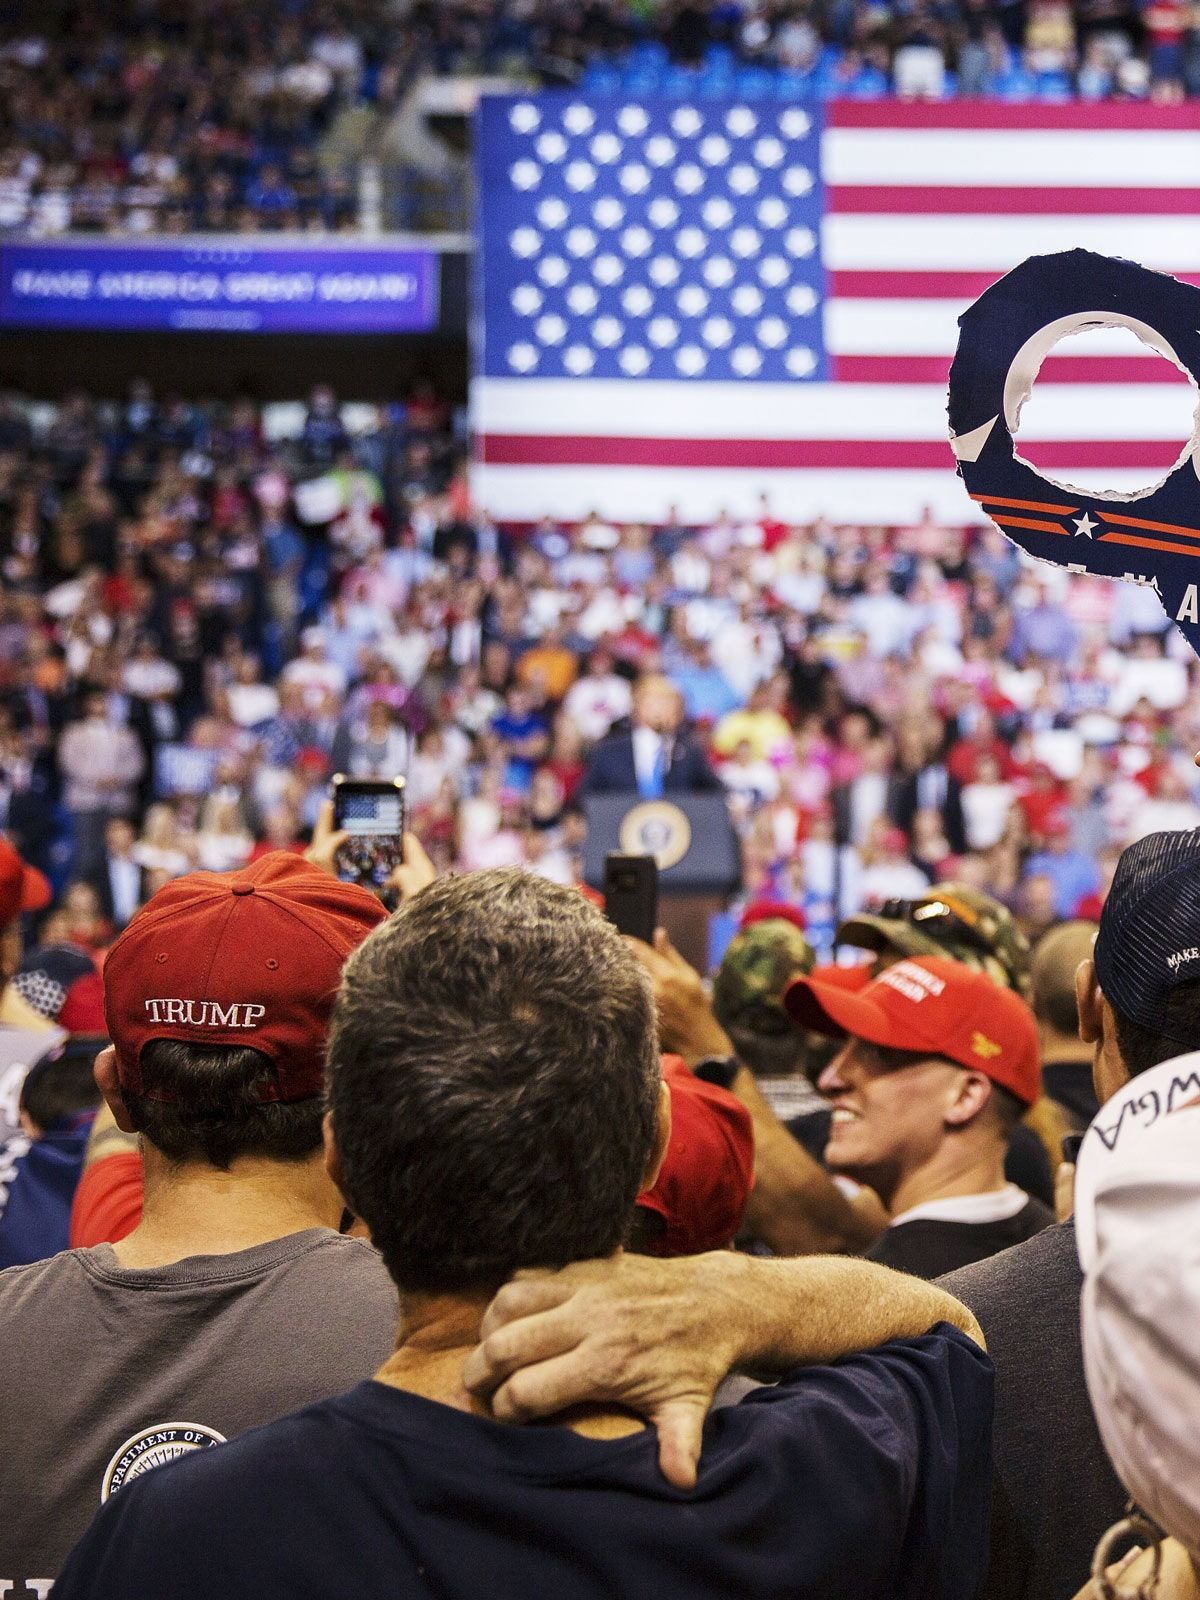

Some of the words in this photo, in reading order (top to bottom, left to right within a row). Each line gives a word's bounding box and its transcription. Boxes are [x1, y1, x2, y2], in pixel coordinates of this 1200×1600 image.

[1166, 947, 1199, 968] MAKE
[145, 999, 266, 1027] TRUMP
[110, 1430, 177, 1494] EPARTMENT
[184, 1431, 203, 1443] OF
